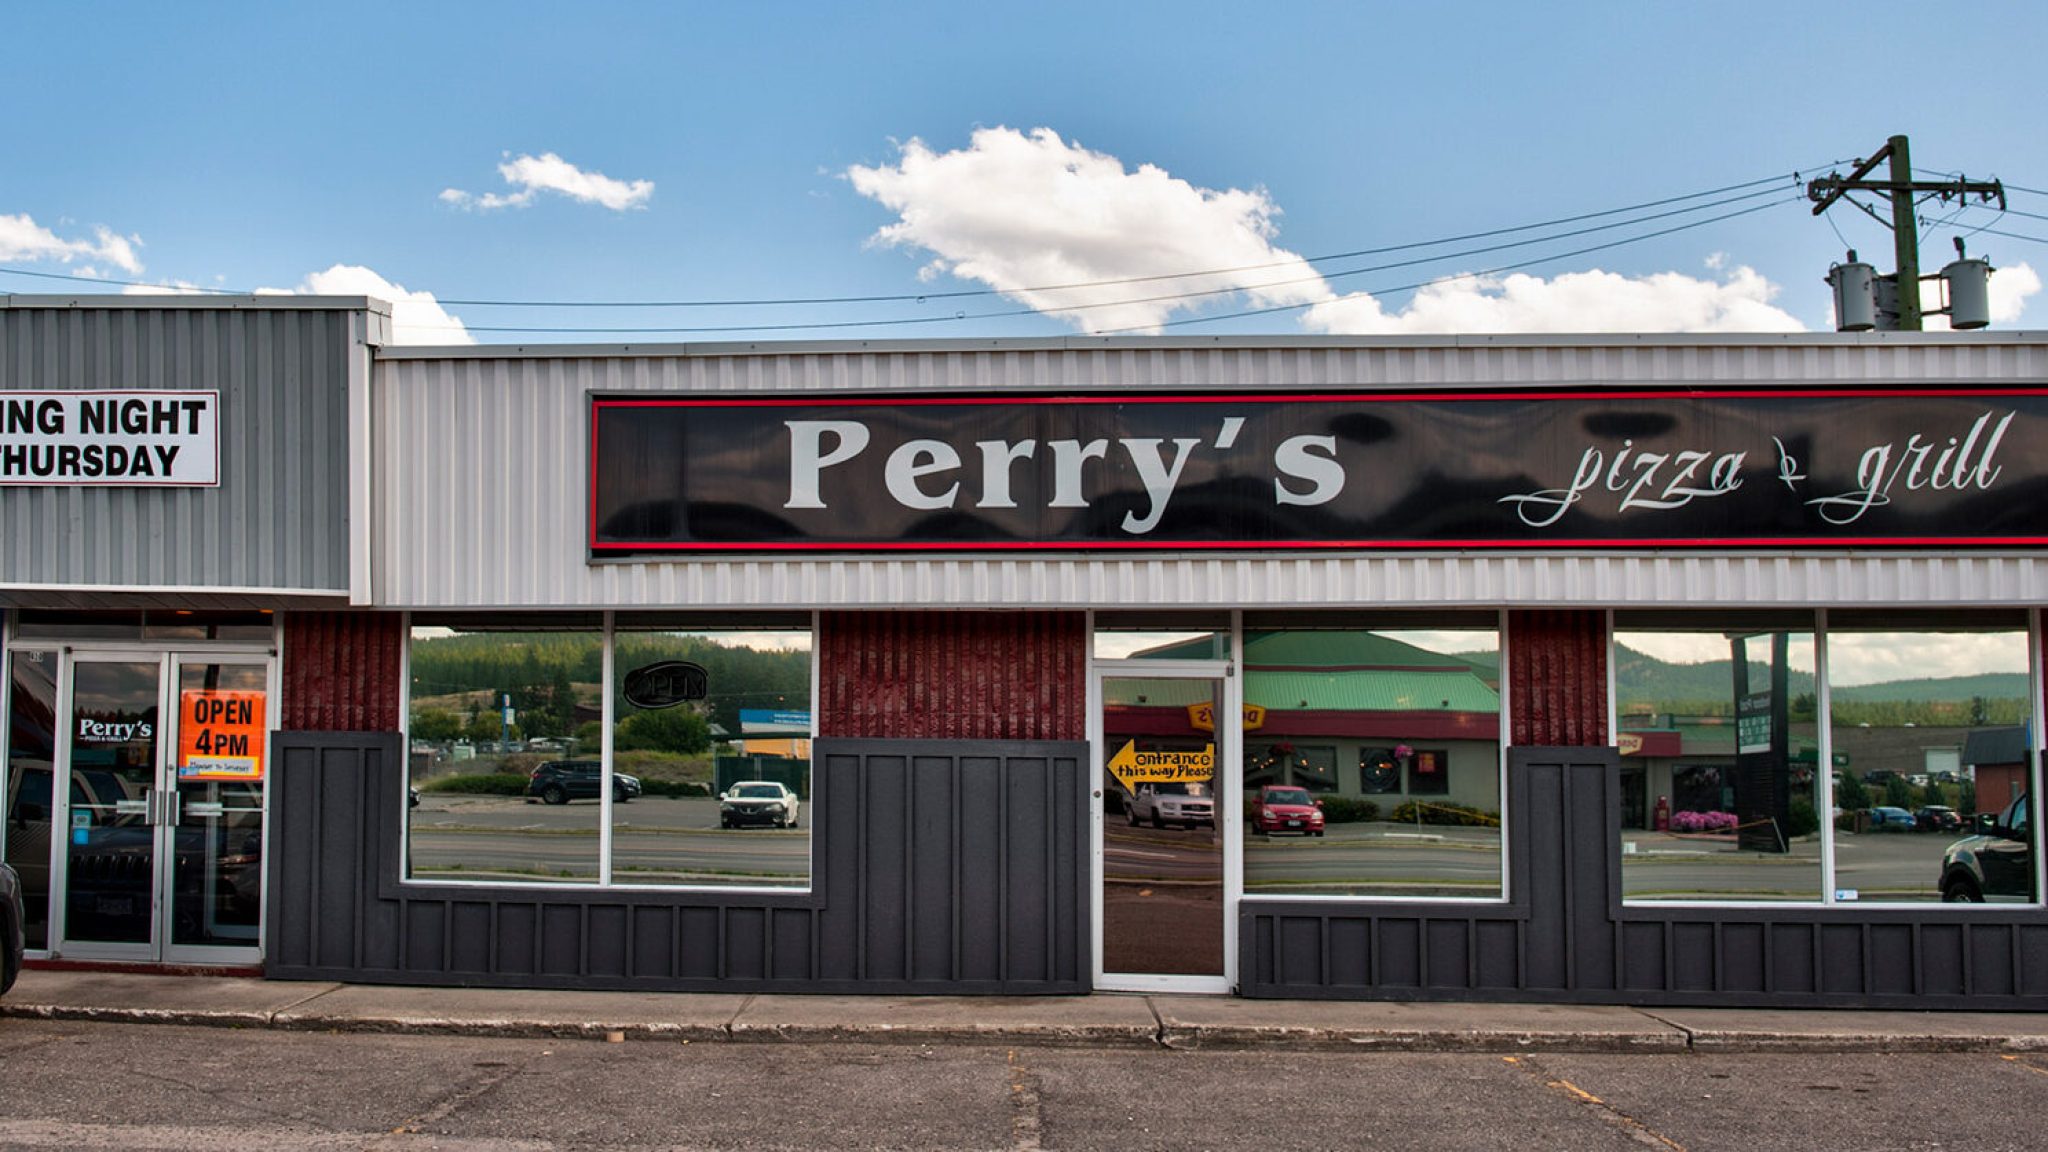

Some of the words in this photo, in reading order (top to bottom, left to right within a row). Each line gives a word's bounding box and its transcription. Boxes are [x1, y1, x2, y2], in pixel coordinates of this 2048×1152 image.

[79, 399, 207, 435] NIGHT
[0, 444, 180, 477] HURSDAY
[783, 416, 1346, 535] Perry's
[1497, 438, 1748, 527] pizza
[1804, 410, 2016, 525] grill
[194, 698, 252, 724] OPEN
[80, 719, 152, 741] Perry's
[195, 728, 212, 755] 4
[215, 734, 248, 756] PM
[1118, 764, 1147, 777] this
[1150, 767, 1176, 779] way
[1135, 753, 1211, 766] entrance
